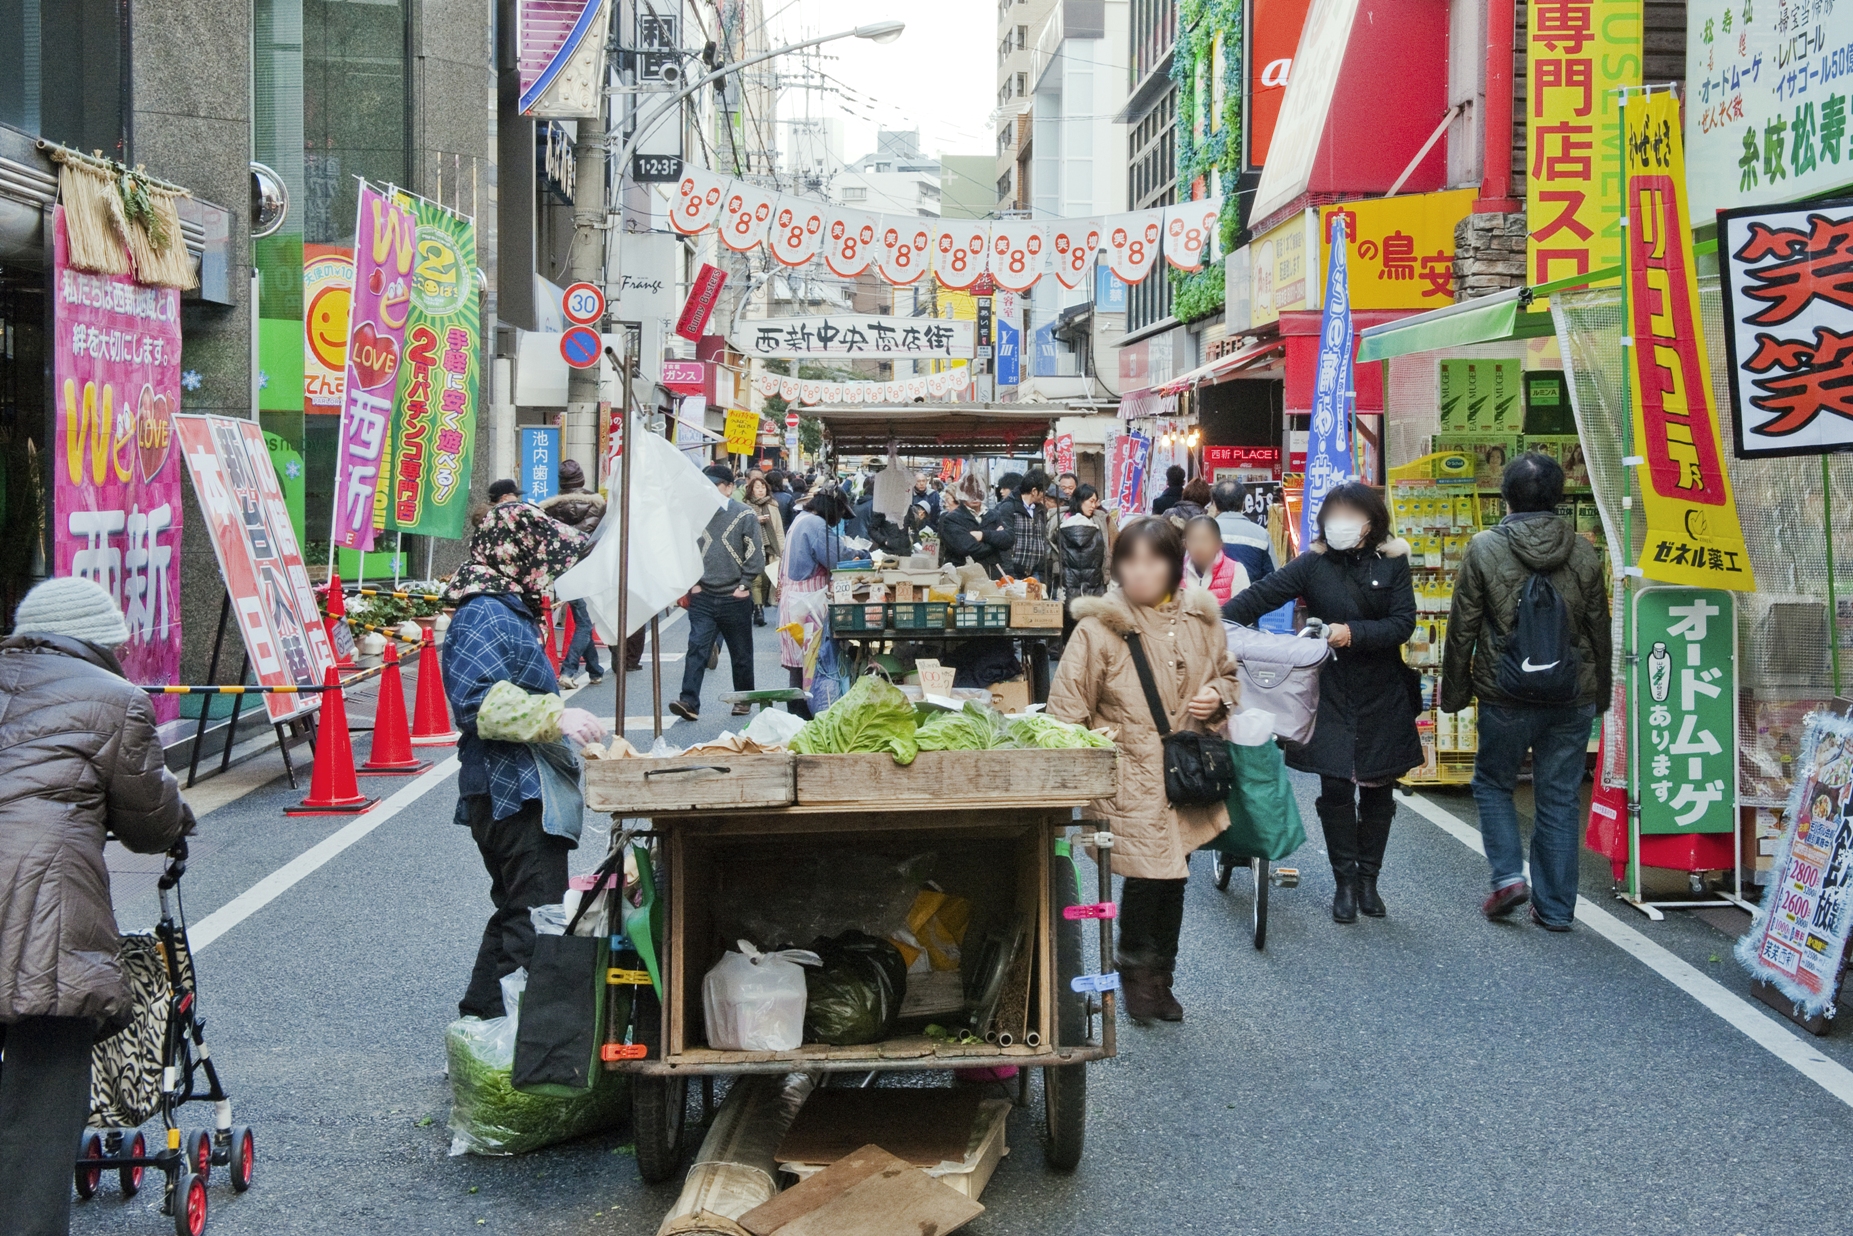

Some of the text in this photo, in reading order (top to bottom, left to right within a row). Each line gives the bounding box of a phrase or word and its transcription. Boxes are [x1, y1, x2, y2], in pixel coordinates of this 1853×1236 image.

[1701, 51, 1763, 104] オードムーゲ
[1701, 92, 1744, 134] ぜんそく散
[1738, 92, 1853, 193] 糸岐松寿
[686, 196, 702, 217] 8
[735, 212, 752, 234] 8
[787, 226, 803, 248] 8
[842, 237, 857, 260] 8
[1128, 241, 1144, 264] 8
[1184, 228, 1202, 252] 8
[895, 244, 911, 267] 8
[951, 248, 967, 272] 8
[1009, 250, 1025, 273] 8
[1072, 247, 1085, 271] 8
[572, 294, 596, 314] 30
[686, 268, 721, 334] Bunny Busters
[72, 322, 168, 366] 絆を大切にします。
[756, 319, 954, 355] 西新中央商店街
[352, 342, 395, 373] LOVE
[663, 370, 696, 381] ガンス
[1532, 389, 1558, 397] ルミンA
[140, 418, 169, 448] LOVE
[396, 327, 437, 521] 2円パチンコ専門店
[532, 430, 548, 498] 池内歯科
[1211, 449, 1231, 460] 西新
[189, 445, 282, 676] 本日
[214, 424, 318, 698] 新台入替
[1653, 541, 1742, 572] ゼネル薬工
[1027, 584, 1040, 593] 50
[1666, 598, 1725, 826] オードムーゲ
[1649, 704, 1673, 803] あります
[1790, 860, 1818, 888] 2800
[1782, 890, 1810, 918] 2600
